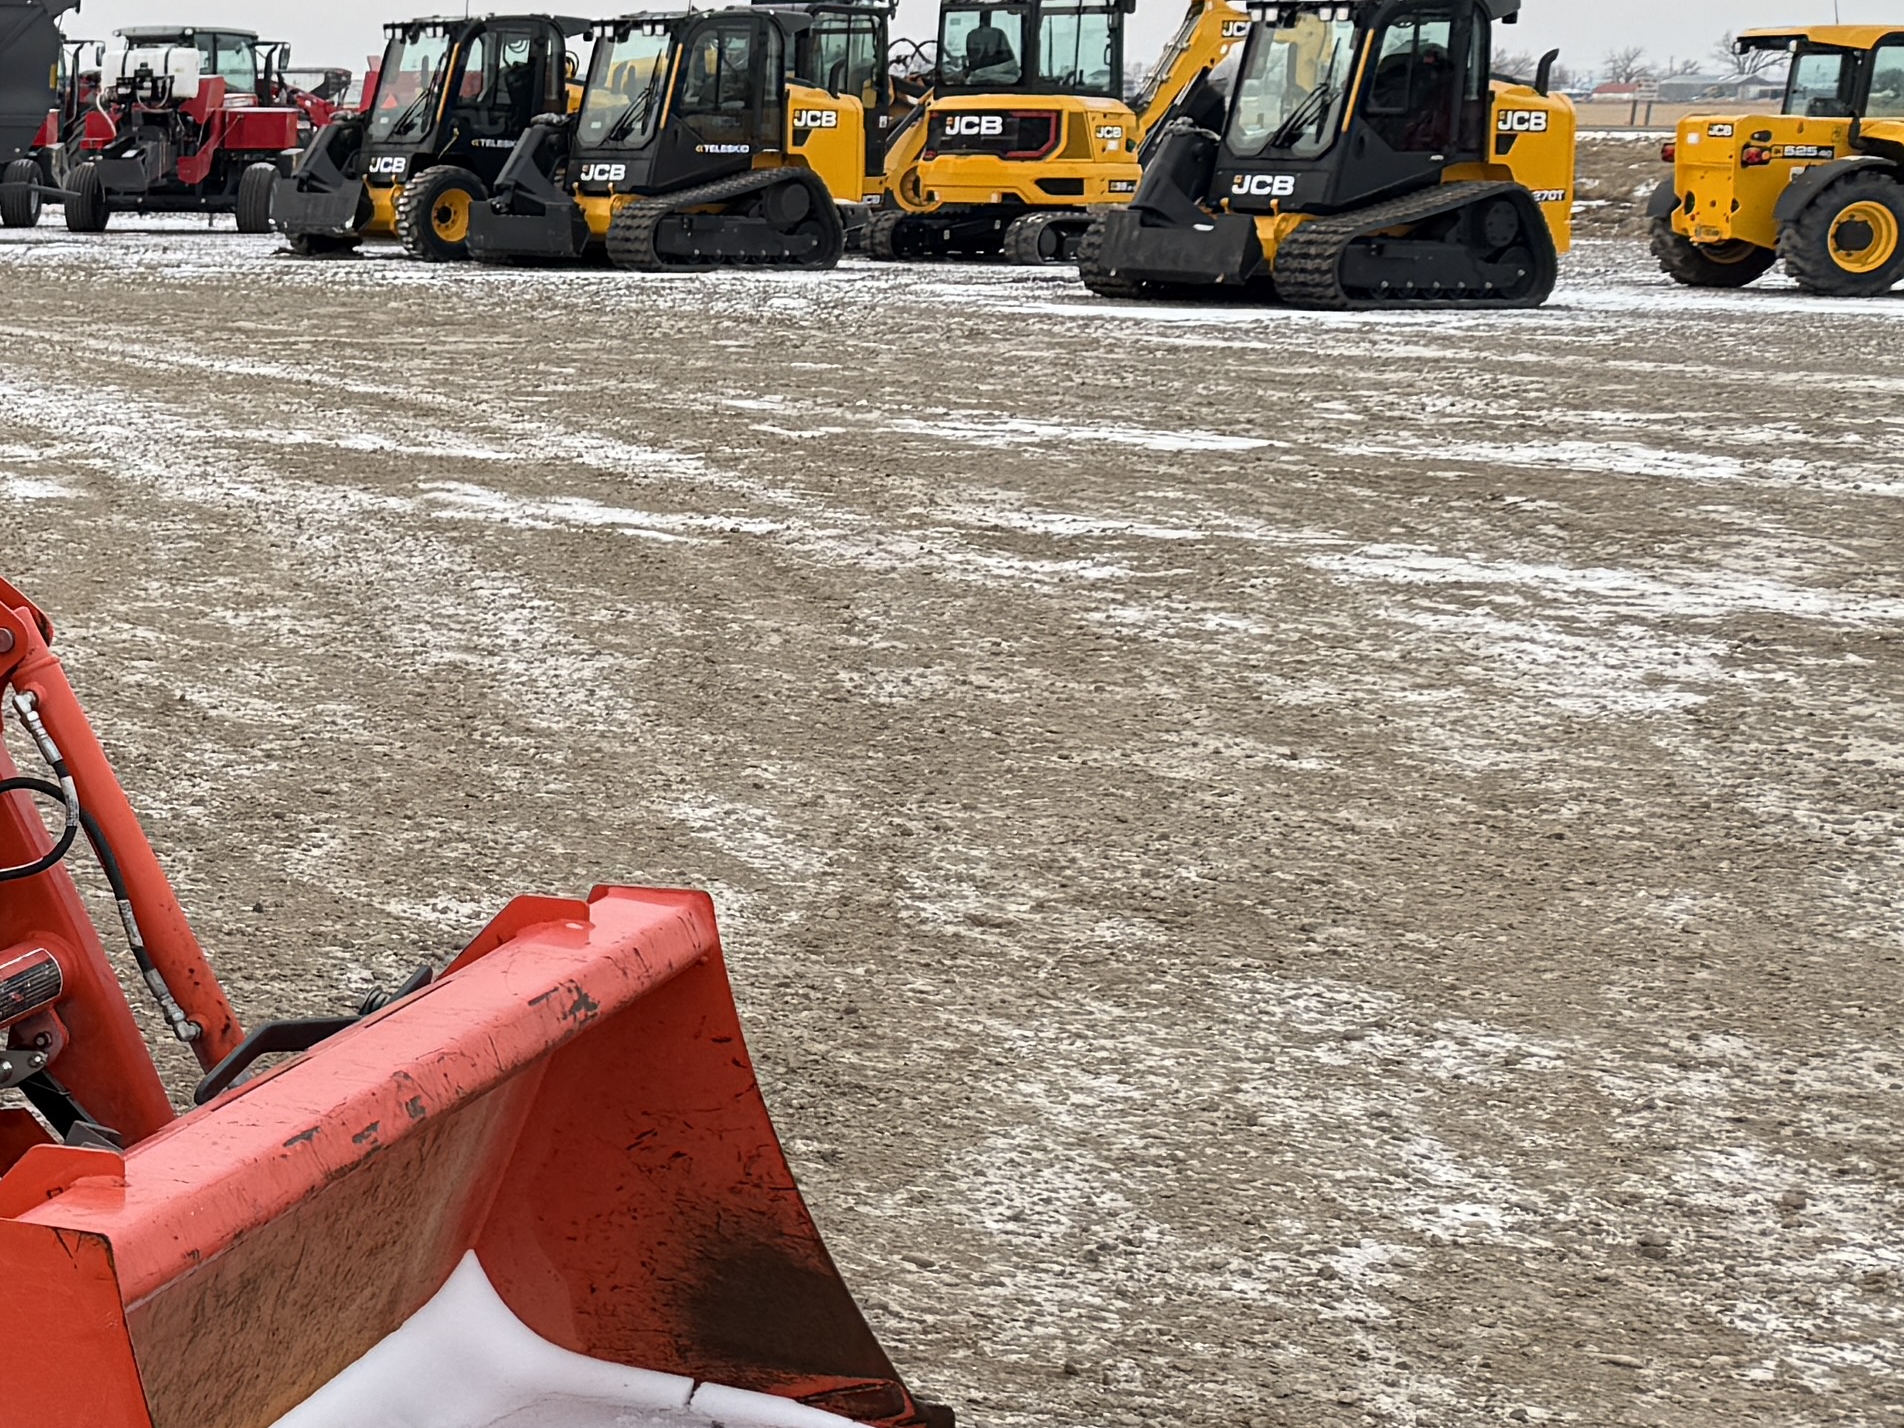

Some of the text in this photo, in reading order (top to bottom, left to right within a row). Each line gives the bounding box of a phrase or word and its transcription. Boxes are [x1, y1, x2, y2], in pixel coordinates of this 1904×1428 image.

[1222, 23, 1250, 37] JC
[793, 110, 837, 127] JCB
[945, 115, 1003, 135] JCB
[1497, 110, 1547, 131] JCB
[1095, 126, 1123, 138] JCB
[368, 157, 407, 173] JCB
[580, 164, 627, 181] JCB
[1231, 174, 1295, 196] JCB
